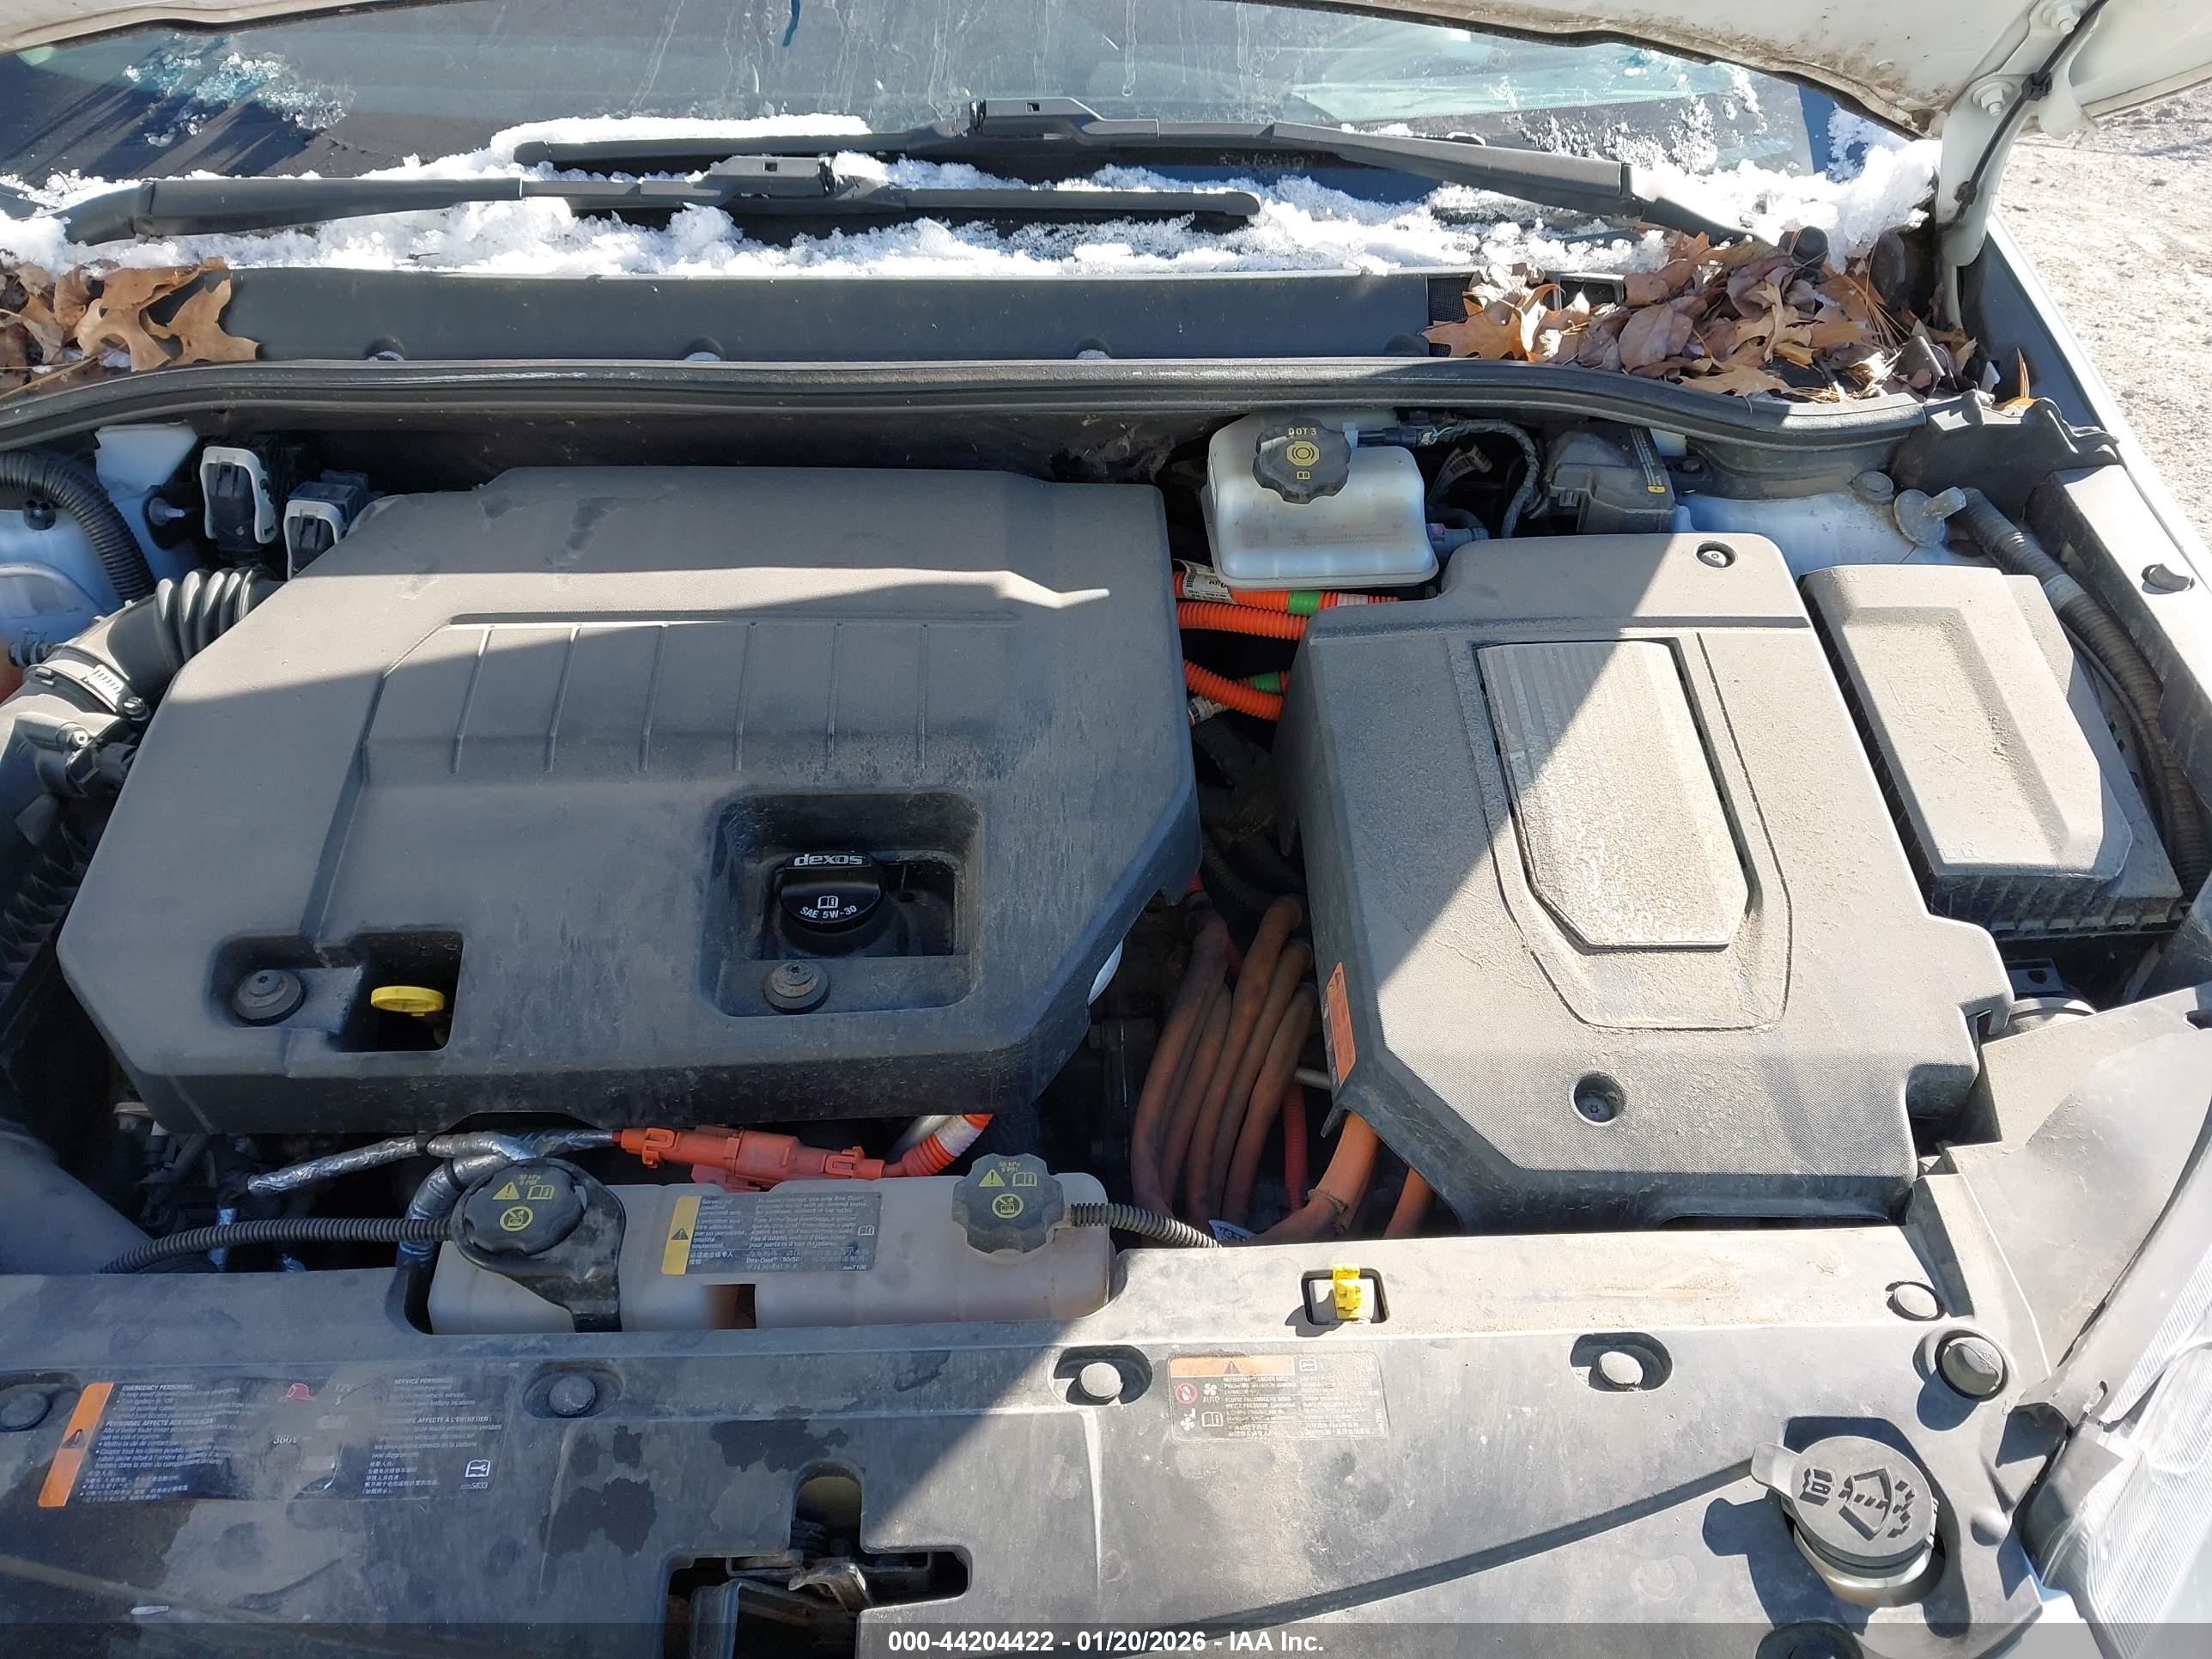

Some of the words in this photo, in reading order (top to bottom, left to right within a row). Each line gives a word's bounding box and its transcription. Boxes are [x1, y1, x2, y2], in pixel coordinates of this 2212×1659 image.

[794, 854, 866, 866] dexos
[800, 907, 819, 919] SAE
[823, 905, 858, 920] 5W-30
[1202, 1395, 1220, 1404] AUTO
